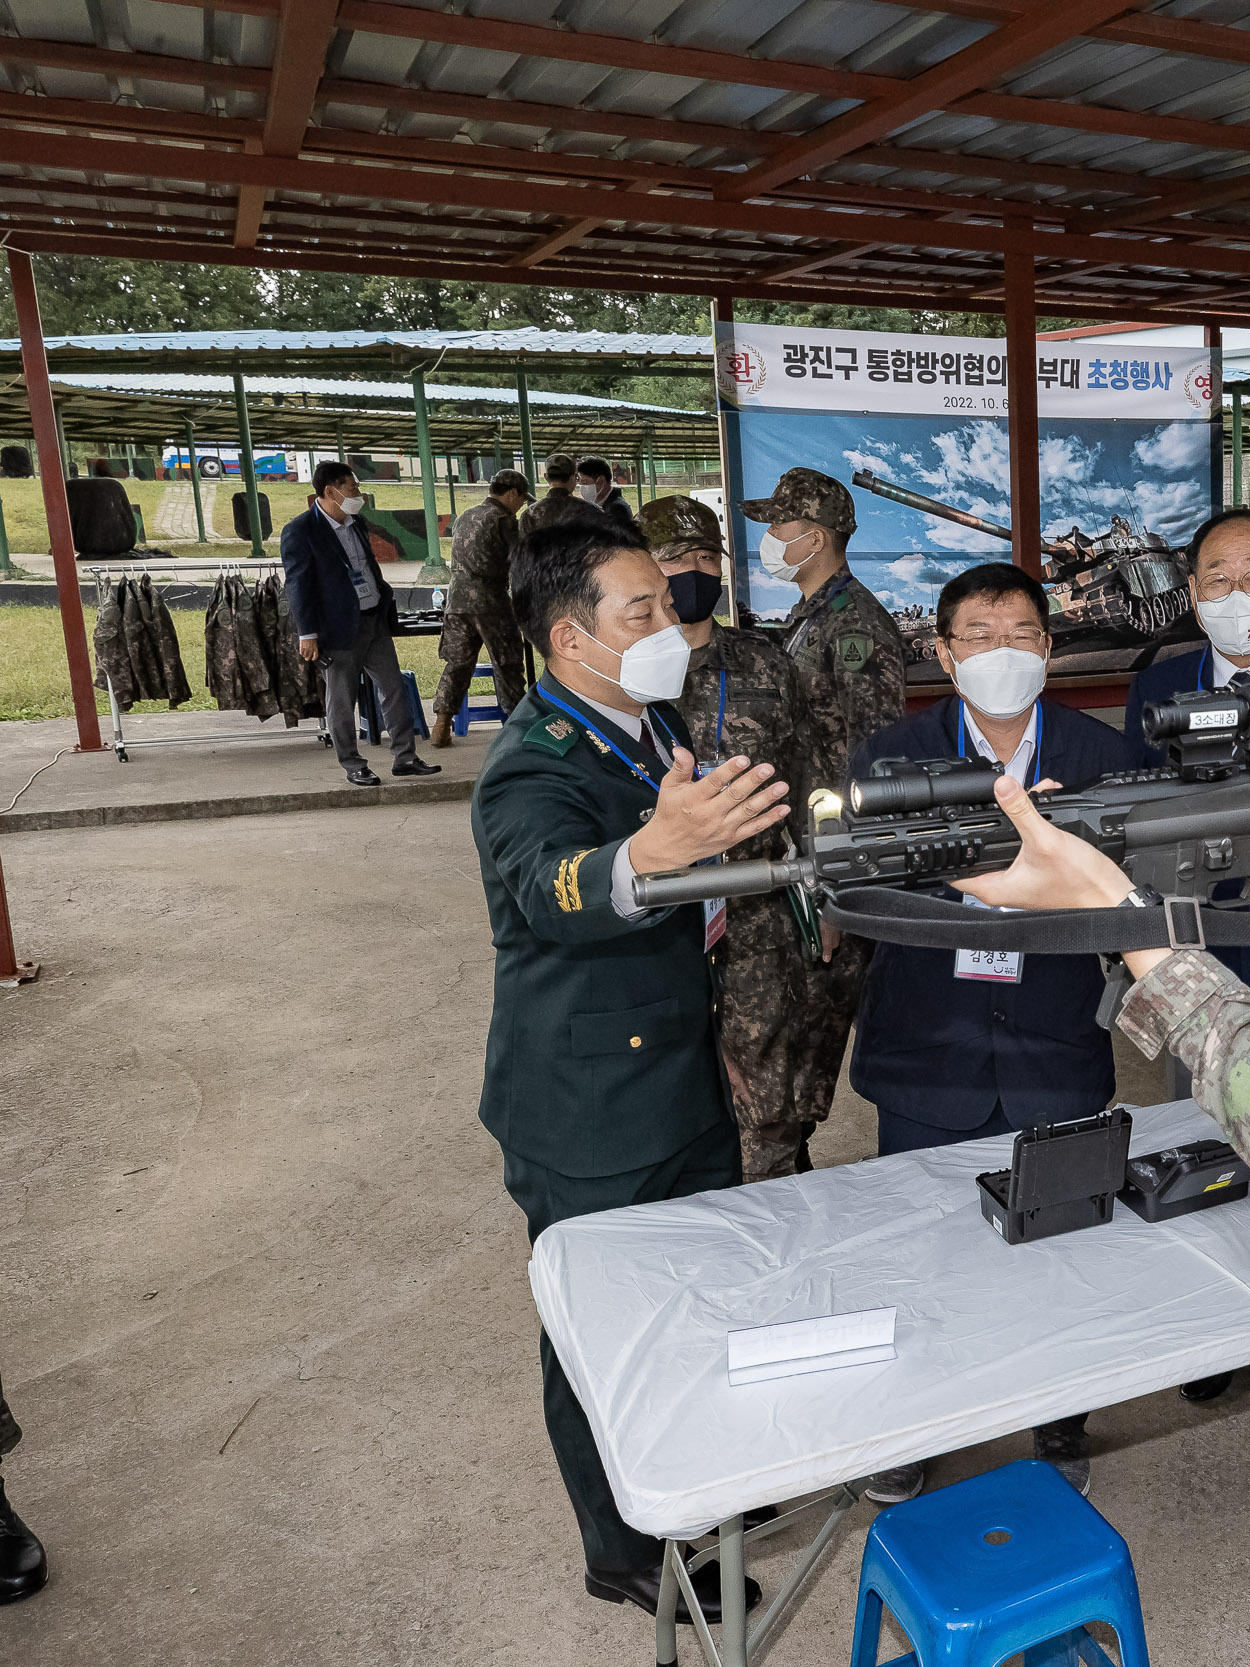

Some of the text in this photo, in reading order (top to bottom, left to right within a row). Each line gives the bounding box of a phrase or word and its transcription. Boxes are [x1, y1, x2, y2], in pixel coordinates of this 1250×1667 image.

[725, 353, 756, 382] 환
[783, 344, 1173, 390] 광진구 통합방위협의 부대 초청행사
[1195, 372, 1213, 400] 영
[943, 396, 977, 409] 2022.
[981, 397, 999, 409] 10.
[1194, 712, 1236, 726] 3소대장
